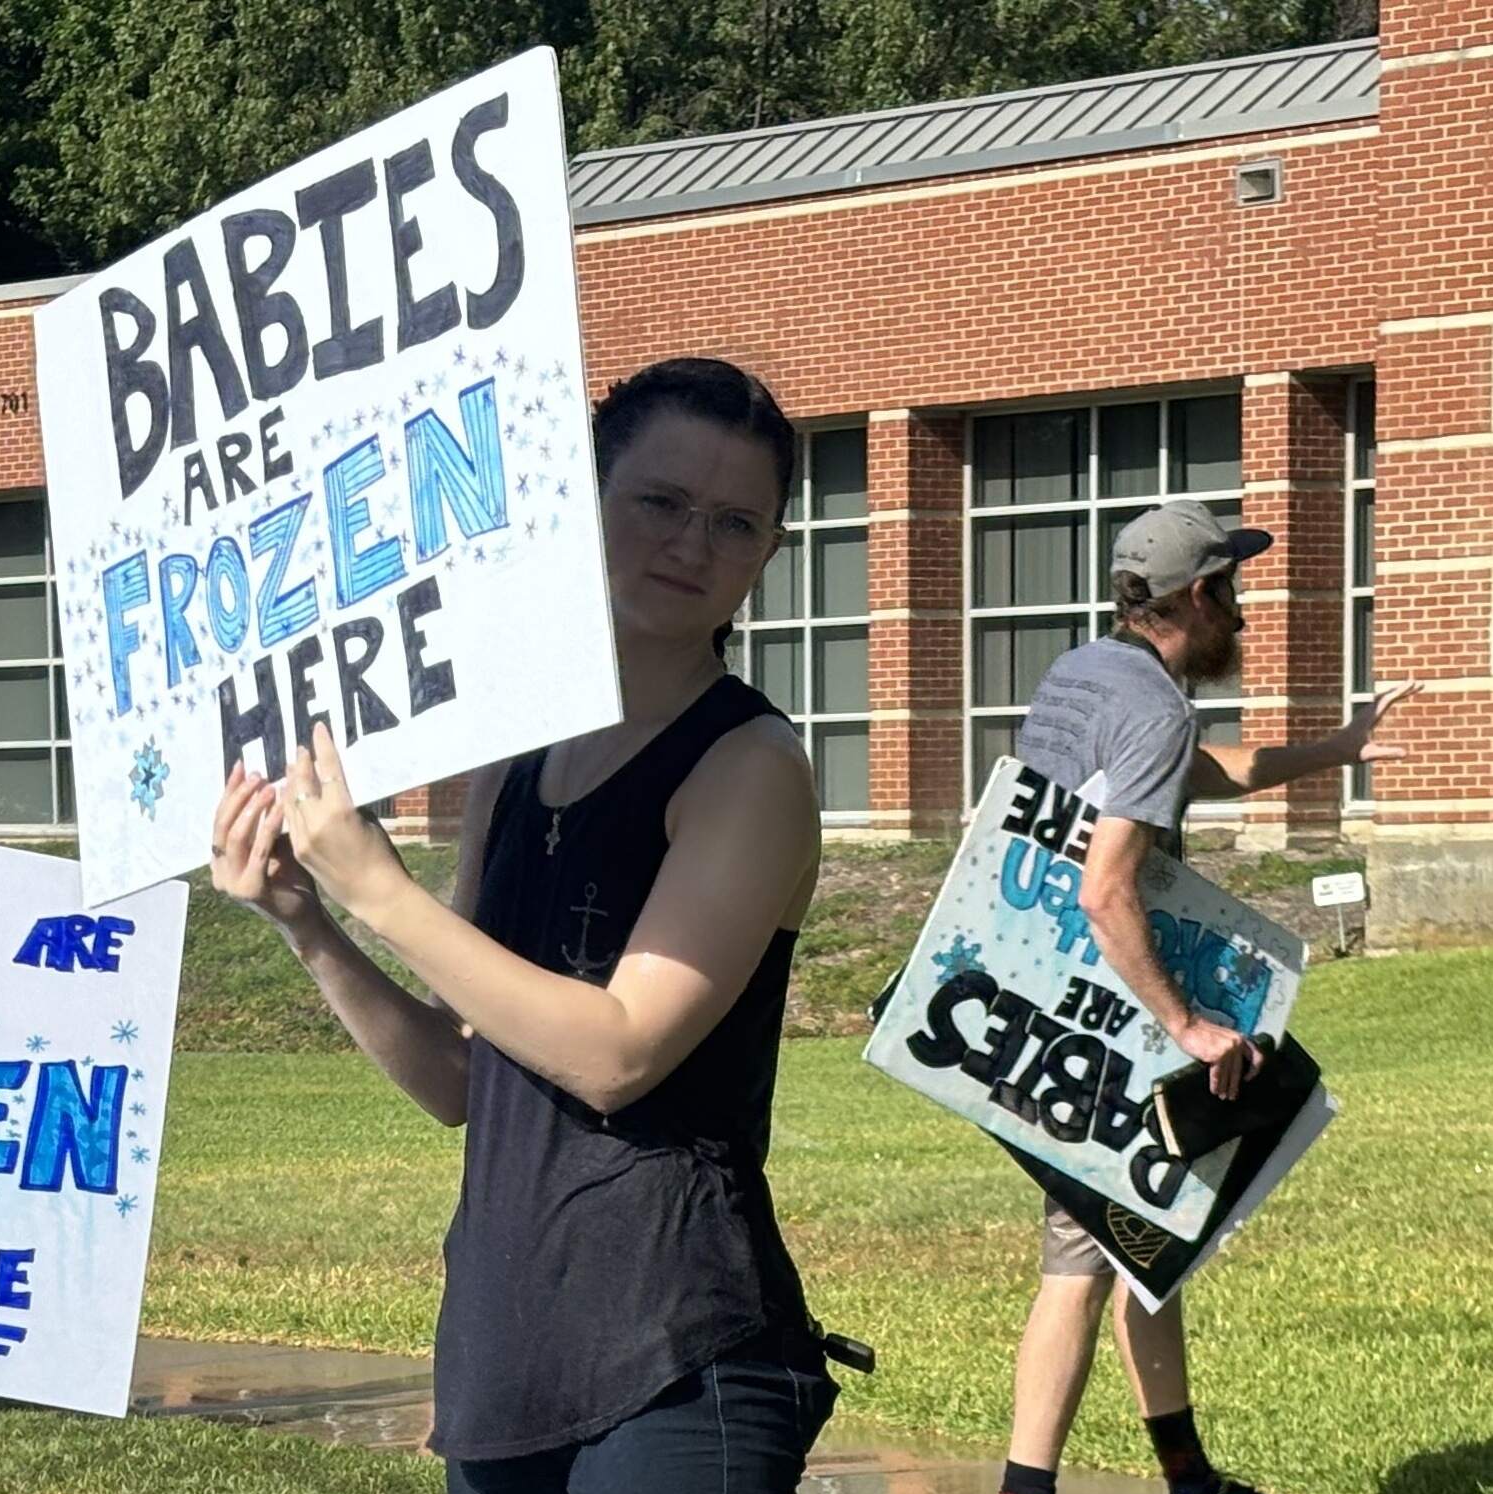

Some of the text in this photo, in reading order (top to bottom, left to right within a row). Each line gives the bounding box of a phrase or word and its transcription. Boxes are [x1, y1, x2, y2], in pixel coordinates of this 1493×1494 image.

[98, 93, 526, 500] BABIES
[103, 376, 509, 716] FROZEN
[182, 408, 294, 526] ARE
[218, 577, 457, 783] HERE
[1002, 766, 1100, 866] ERE
[13, 915, 135, 972] ARE
[1054, 976, 1138, 1037] ARE
[906, 970, 1191, 1210] BABIES
